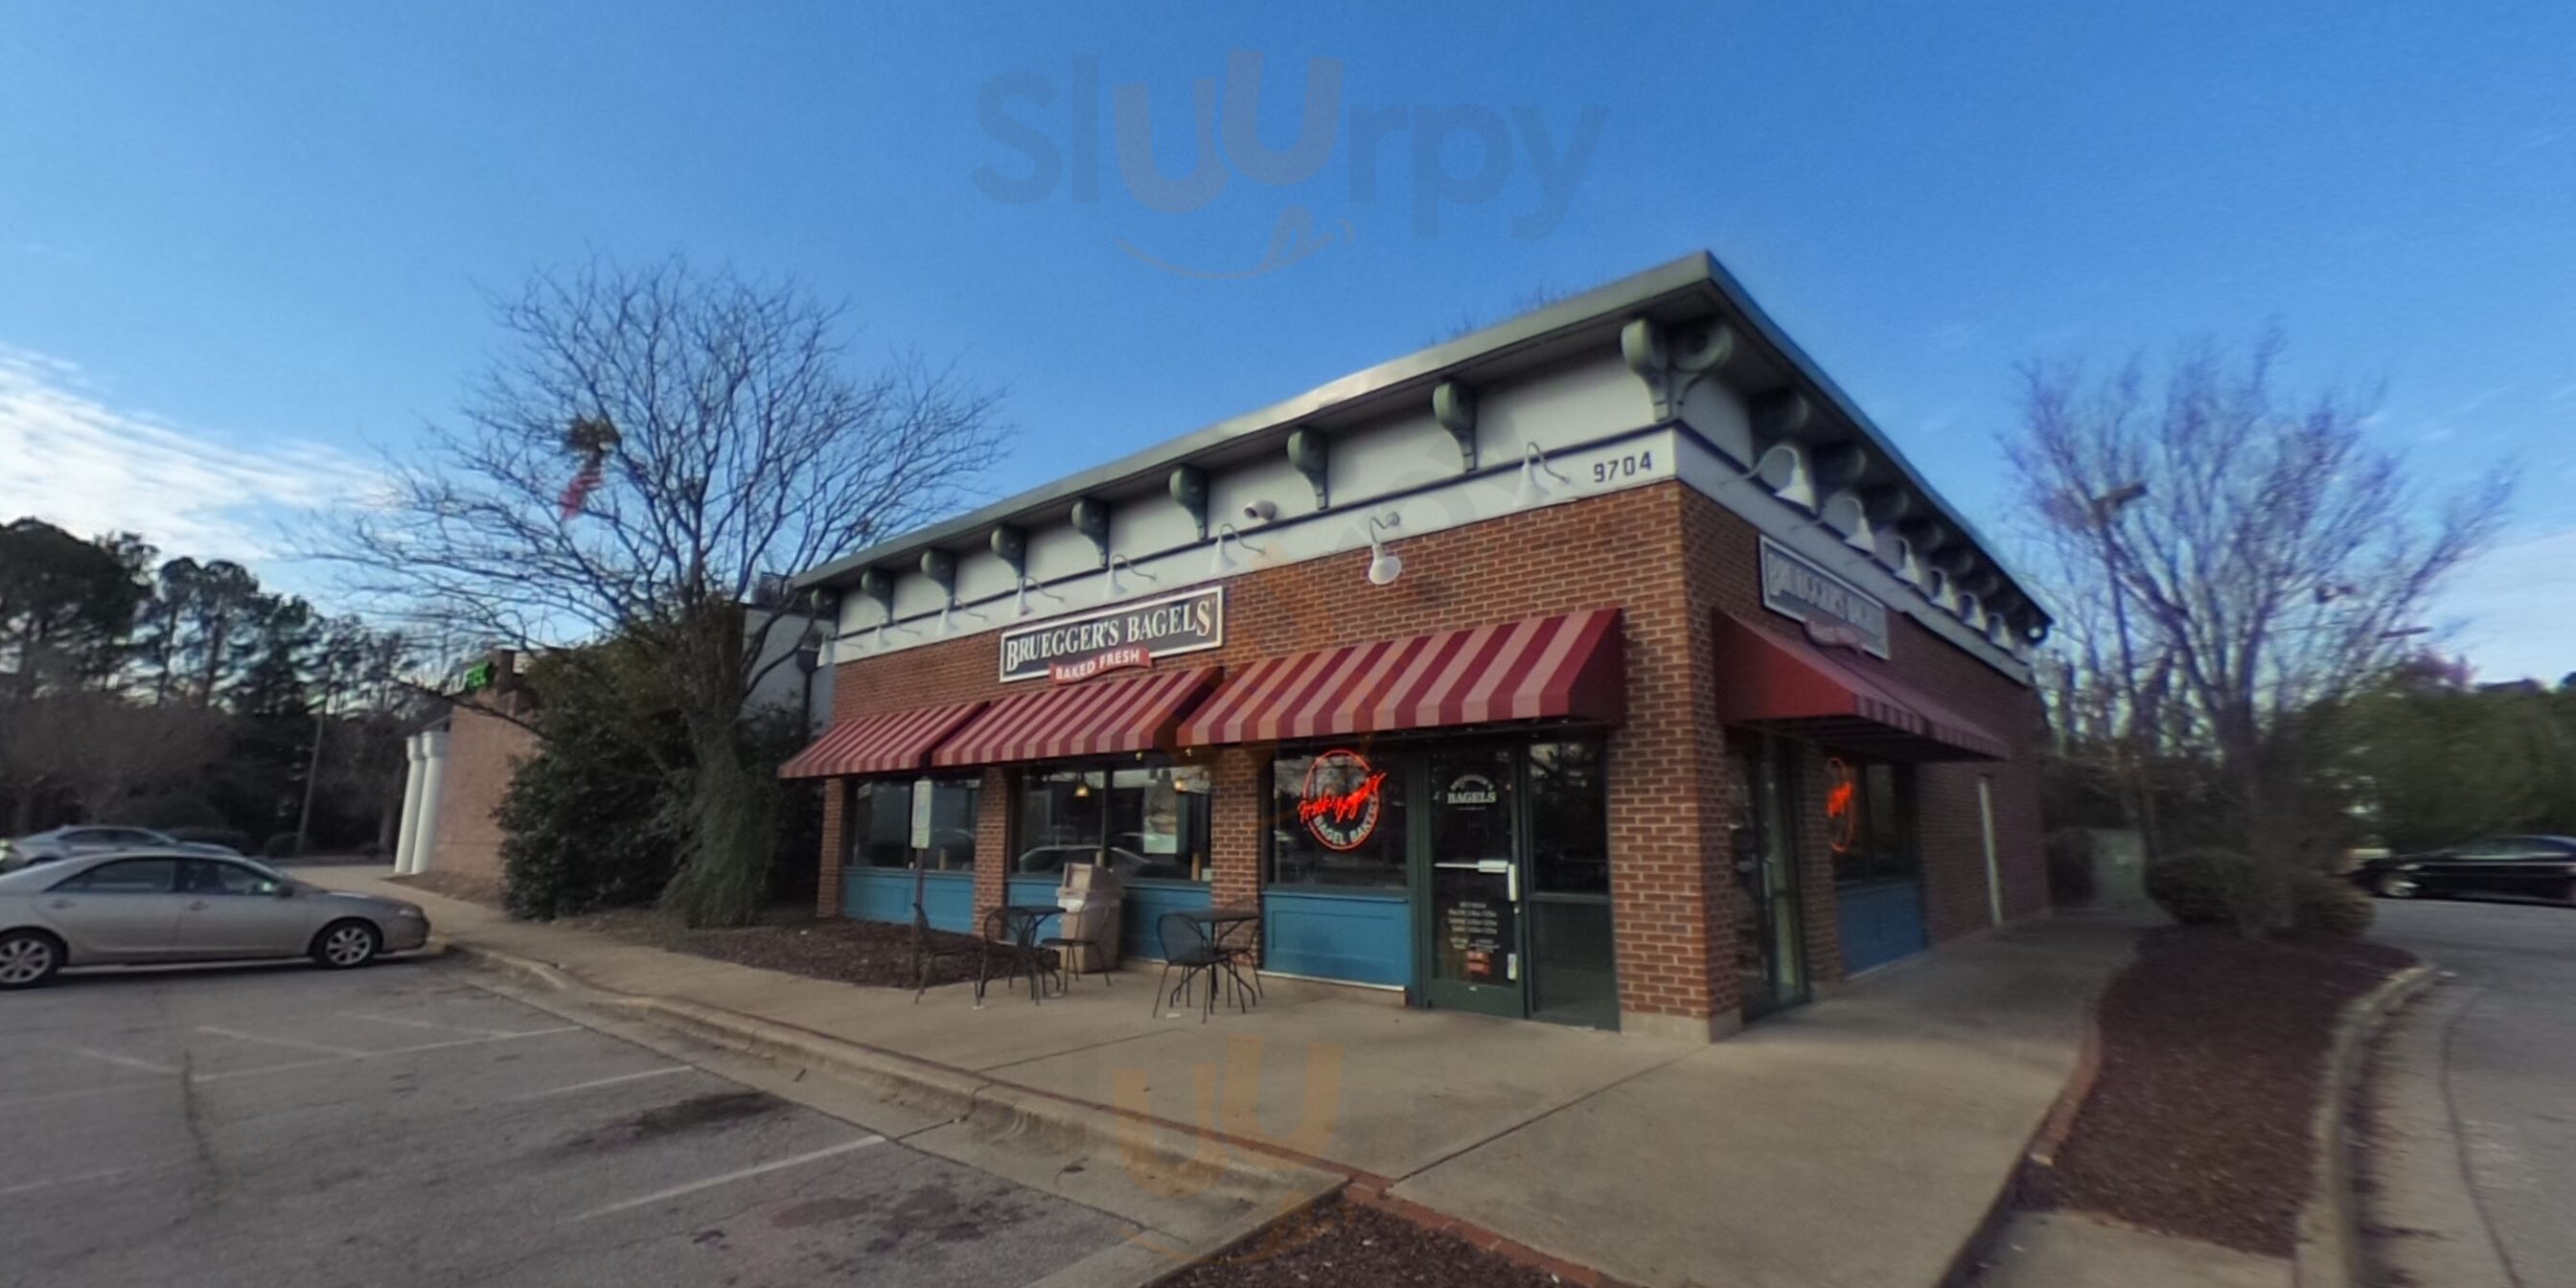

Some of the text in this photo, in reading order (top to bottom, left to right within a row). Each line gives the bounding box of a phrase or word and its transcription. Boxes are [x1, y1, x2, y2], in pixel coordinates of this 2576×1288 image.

[1594, 450, 1651, 483] 9704
[1006, 600, 1210, 671] BRUEGGER'S BAGELS
[1055, 649, 1140, 679] BAKED FRESH
[1447, 792, 1496, 804] BAGELS
